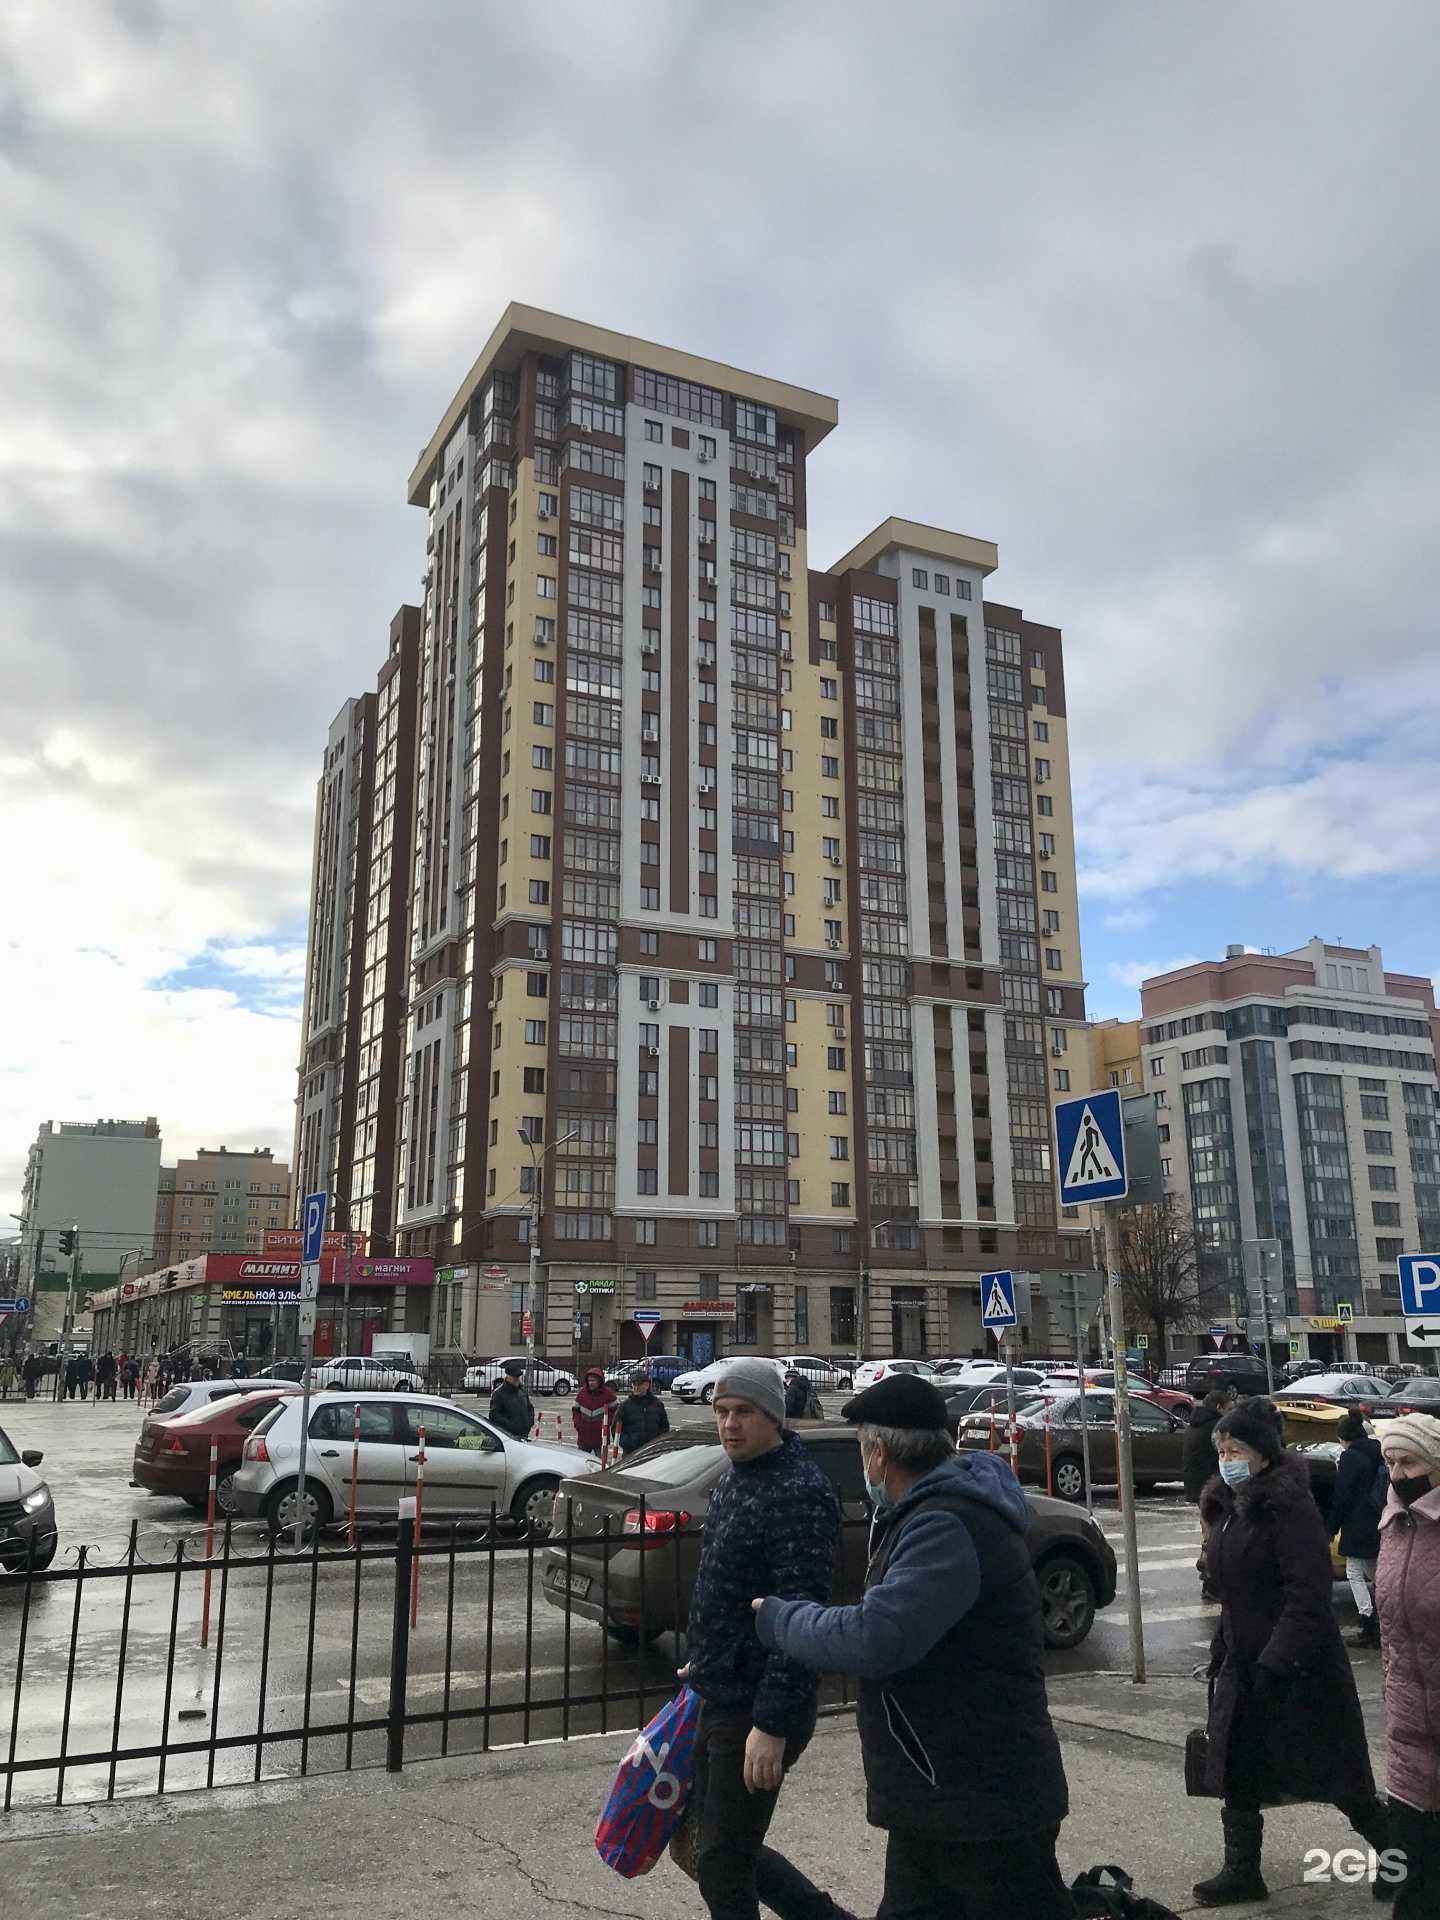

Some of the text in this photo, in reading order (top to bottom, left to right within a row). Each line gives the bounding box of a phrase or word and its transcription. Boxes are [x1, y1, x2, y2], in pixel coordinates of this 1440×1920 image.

[307, 1202, 319, 1254] P
[266, 1235, 341, 1247] СИТИНК
[244, 1263, 299, 1275] МАГНИТ
[1411, 1261, 1440, 1308] P
[222, 1289, 276, 1300] ХМЕЛЬНОЙ
